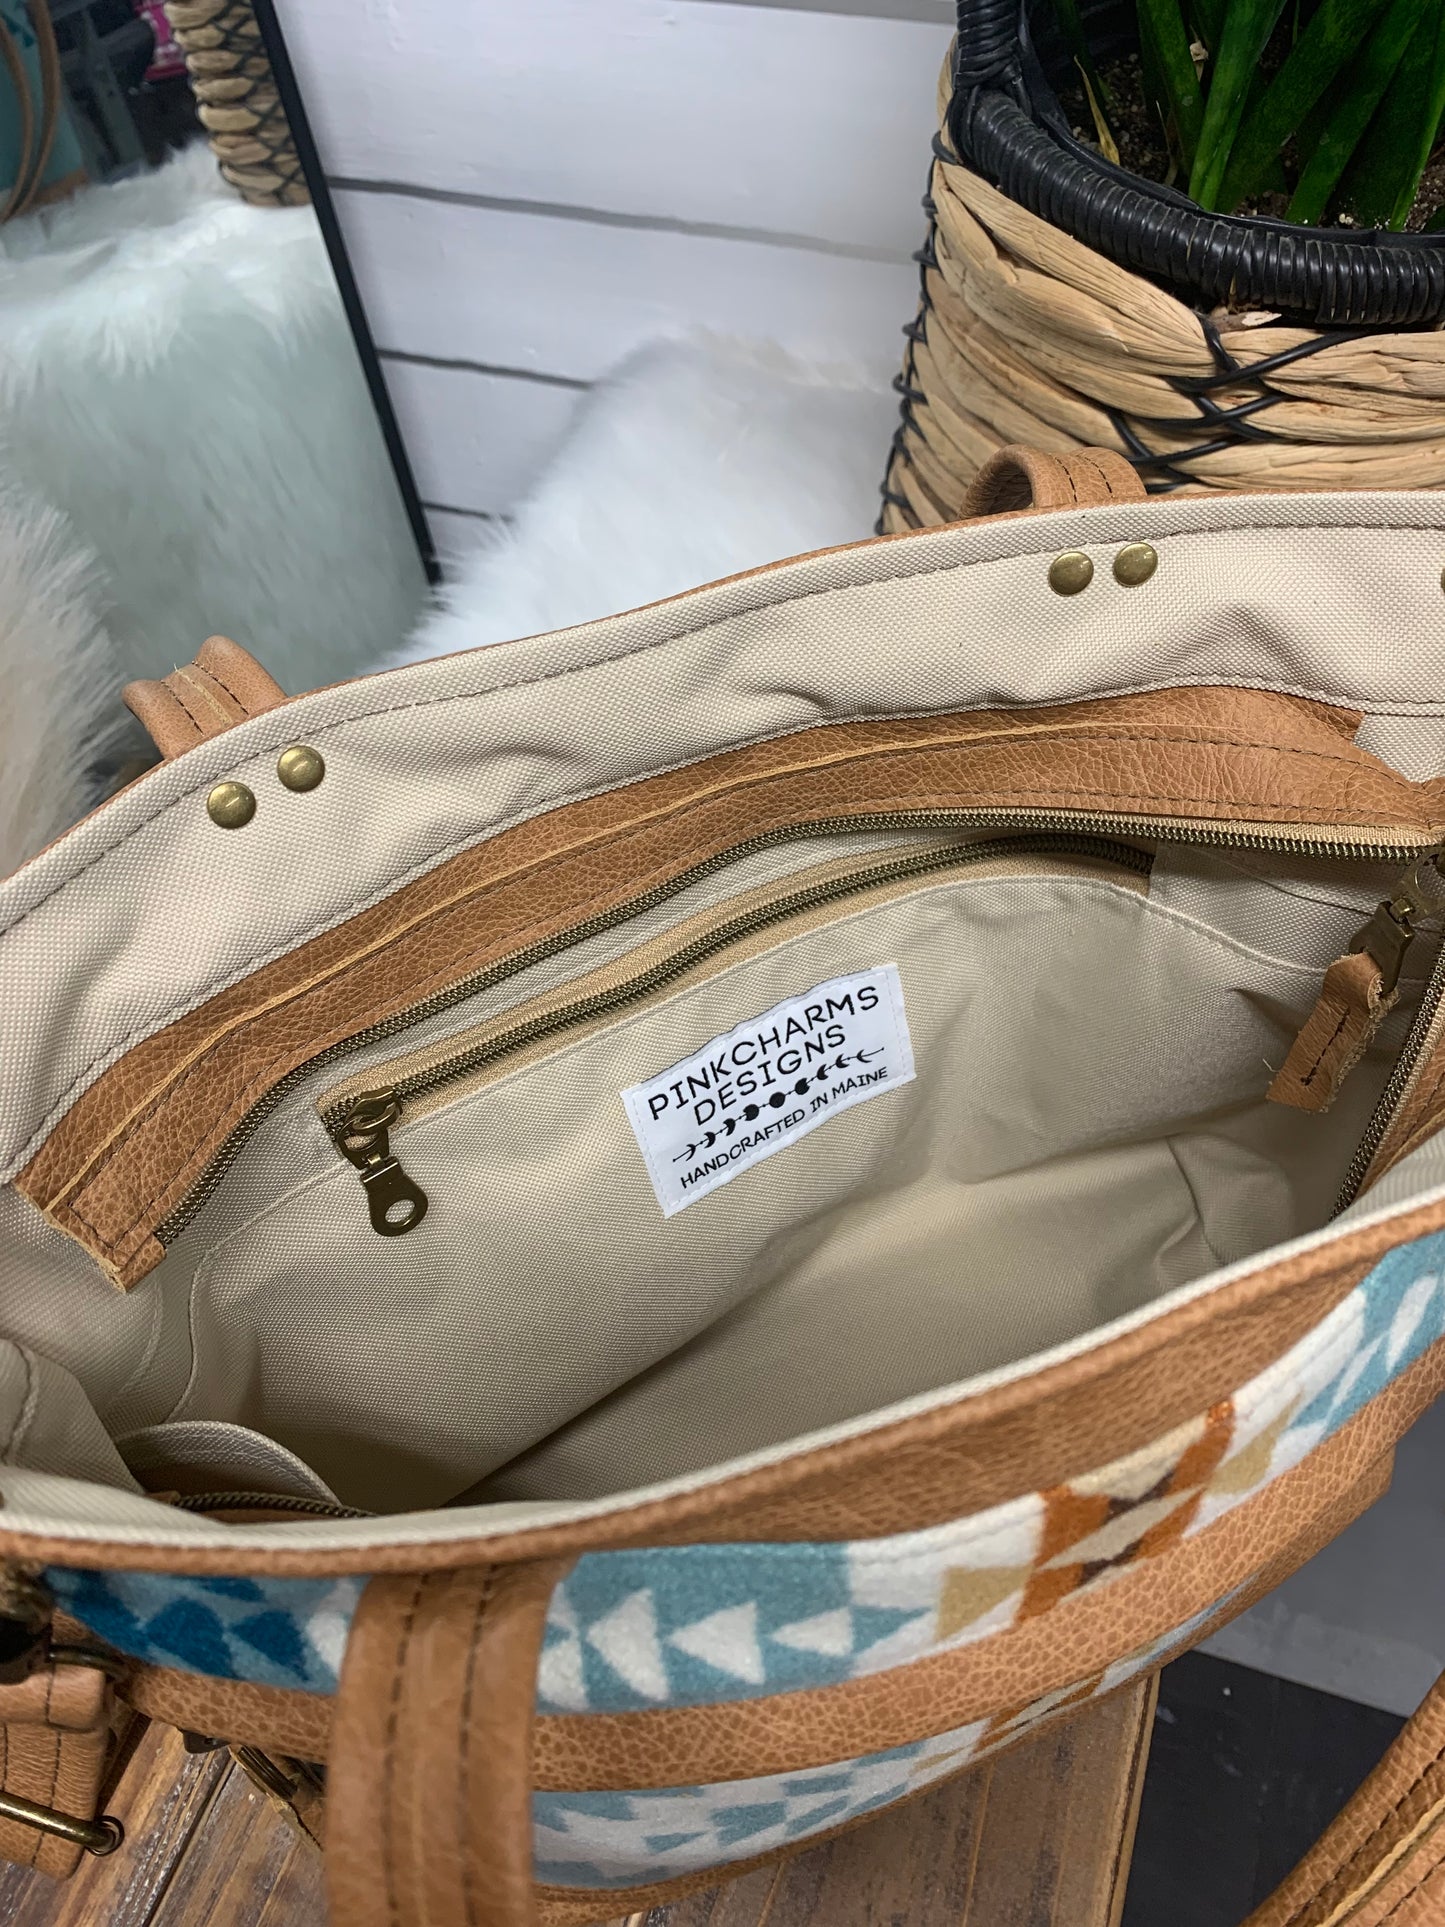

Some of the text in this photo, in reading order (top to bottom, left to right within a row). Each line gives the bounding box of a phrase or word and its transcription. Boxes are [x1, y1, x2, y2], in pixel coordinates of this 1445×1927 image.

[648, 986, 879, 1120] PINKCHARMS
[693, 1024, 846, 1126] DESIGNS
[680, 1066, 888, 1189] HANDCRAFTED IN MAINE
